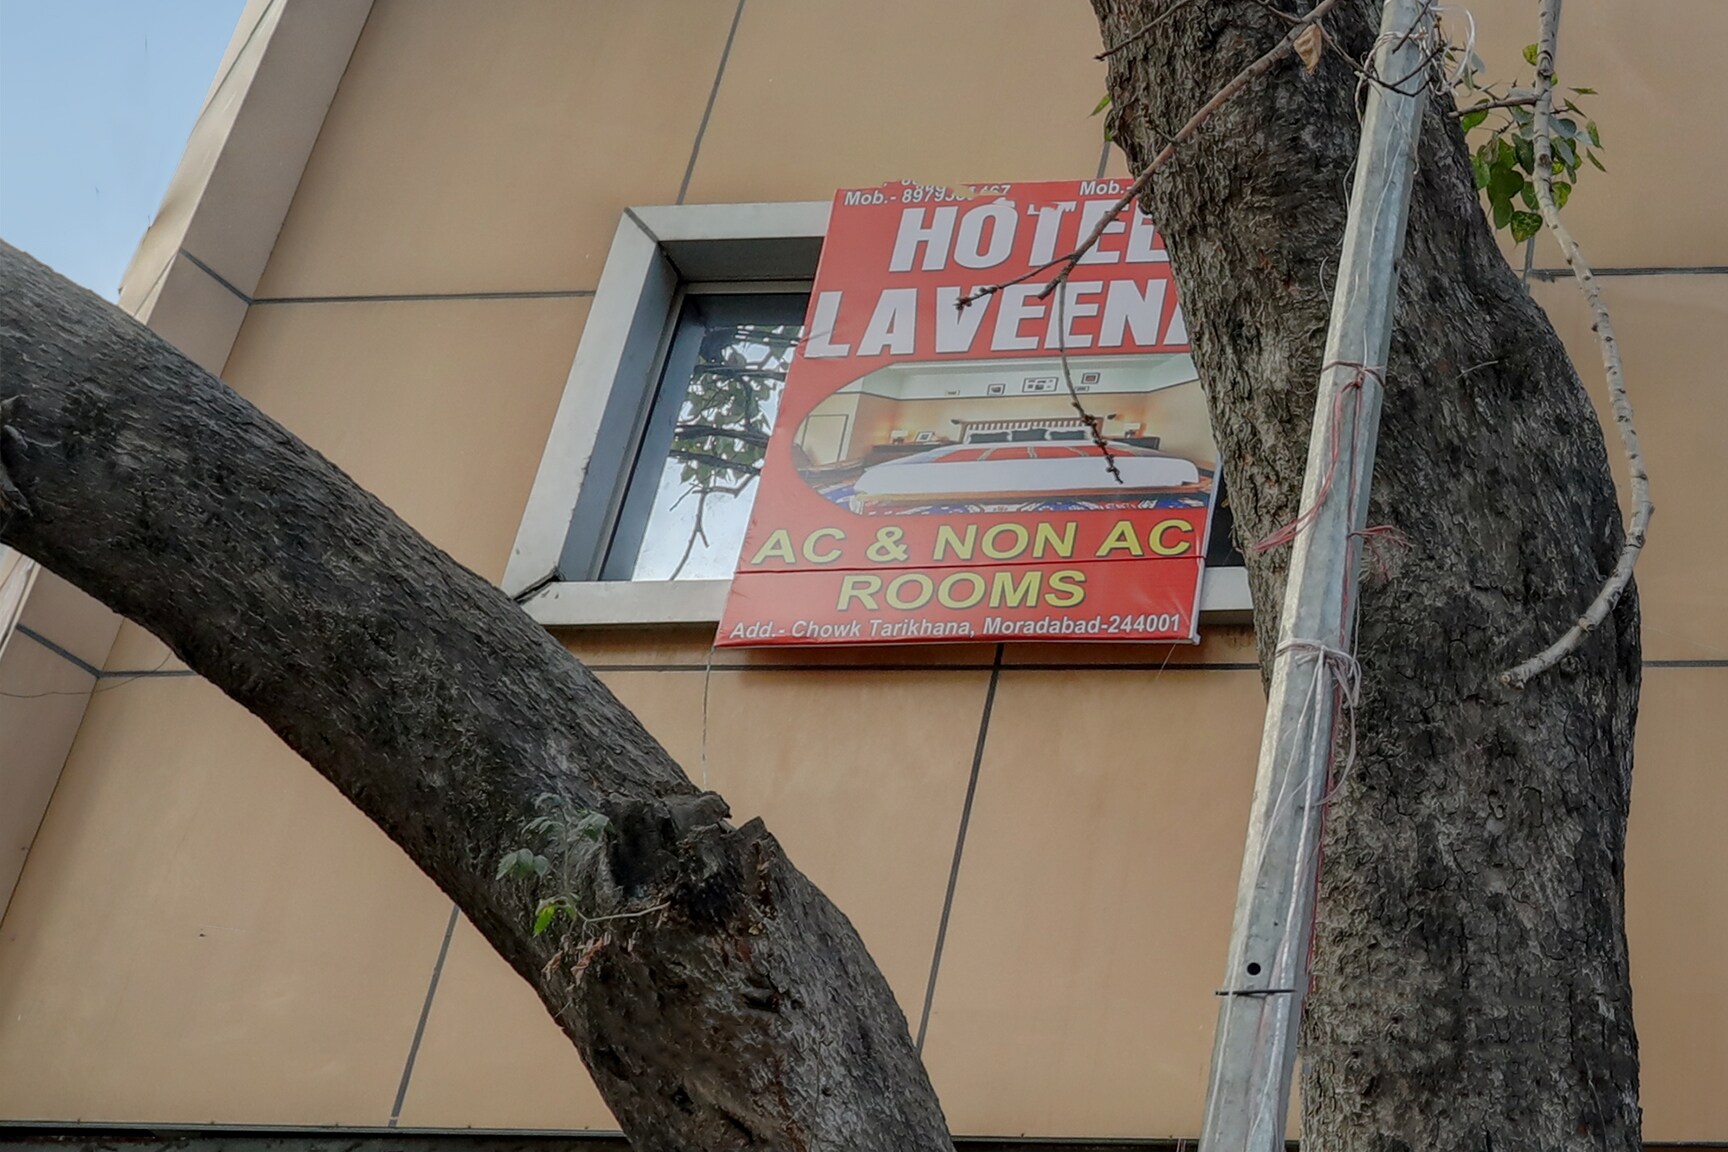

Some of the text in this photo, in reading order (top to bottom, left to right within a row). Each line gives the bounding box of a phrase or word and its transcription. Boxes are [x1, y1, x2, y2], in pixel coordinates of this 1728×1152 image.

[750, 518, 1193, 565] AC & NON AC
[835, 569, 1088, 611] ROOMS
[790, 619, 861, 638] Chowk
[868, 618, 976, 639] Tarikhana,
[982, 613, 1181, 636] Moradabad-244001
